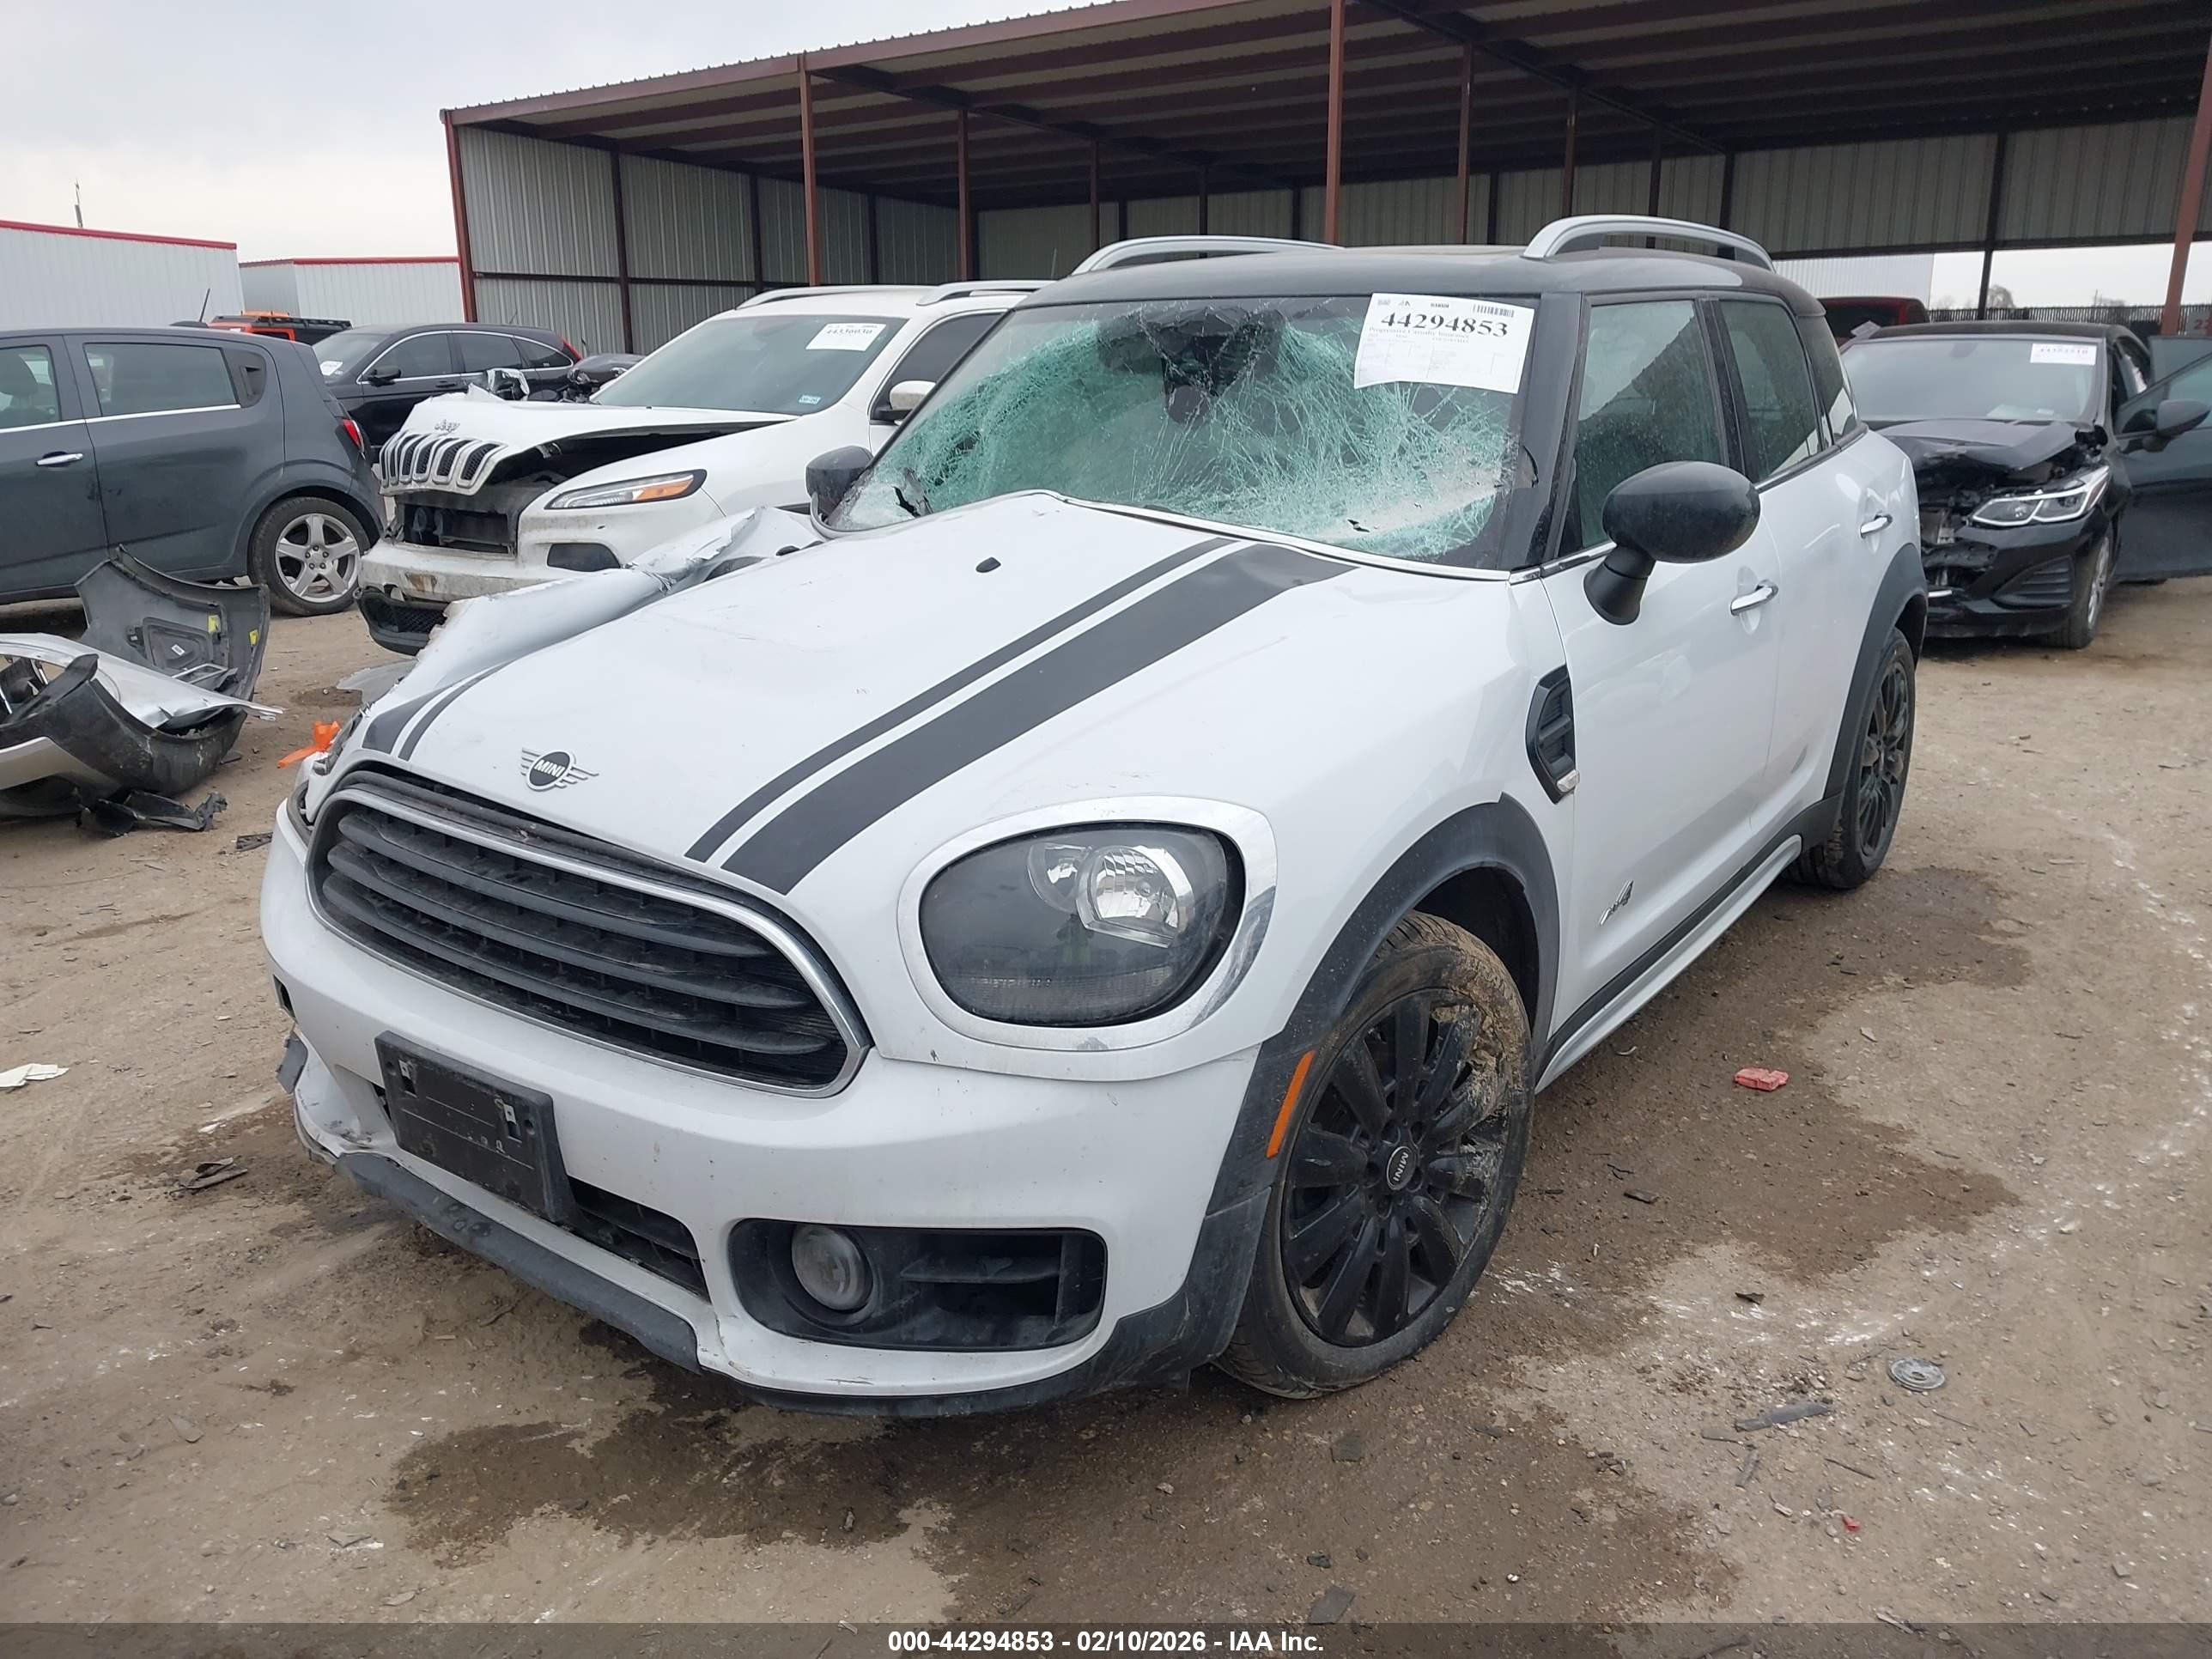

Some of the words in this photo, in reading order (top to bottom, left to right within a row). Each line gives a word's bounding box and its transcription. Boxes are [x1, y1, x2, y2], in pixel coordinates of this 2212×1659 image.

[1381, 312, 1508, 337] 44294853
[533, 758, 566, 778] MINI
[1393, 1152, 1409, 1182] MINI
